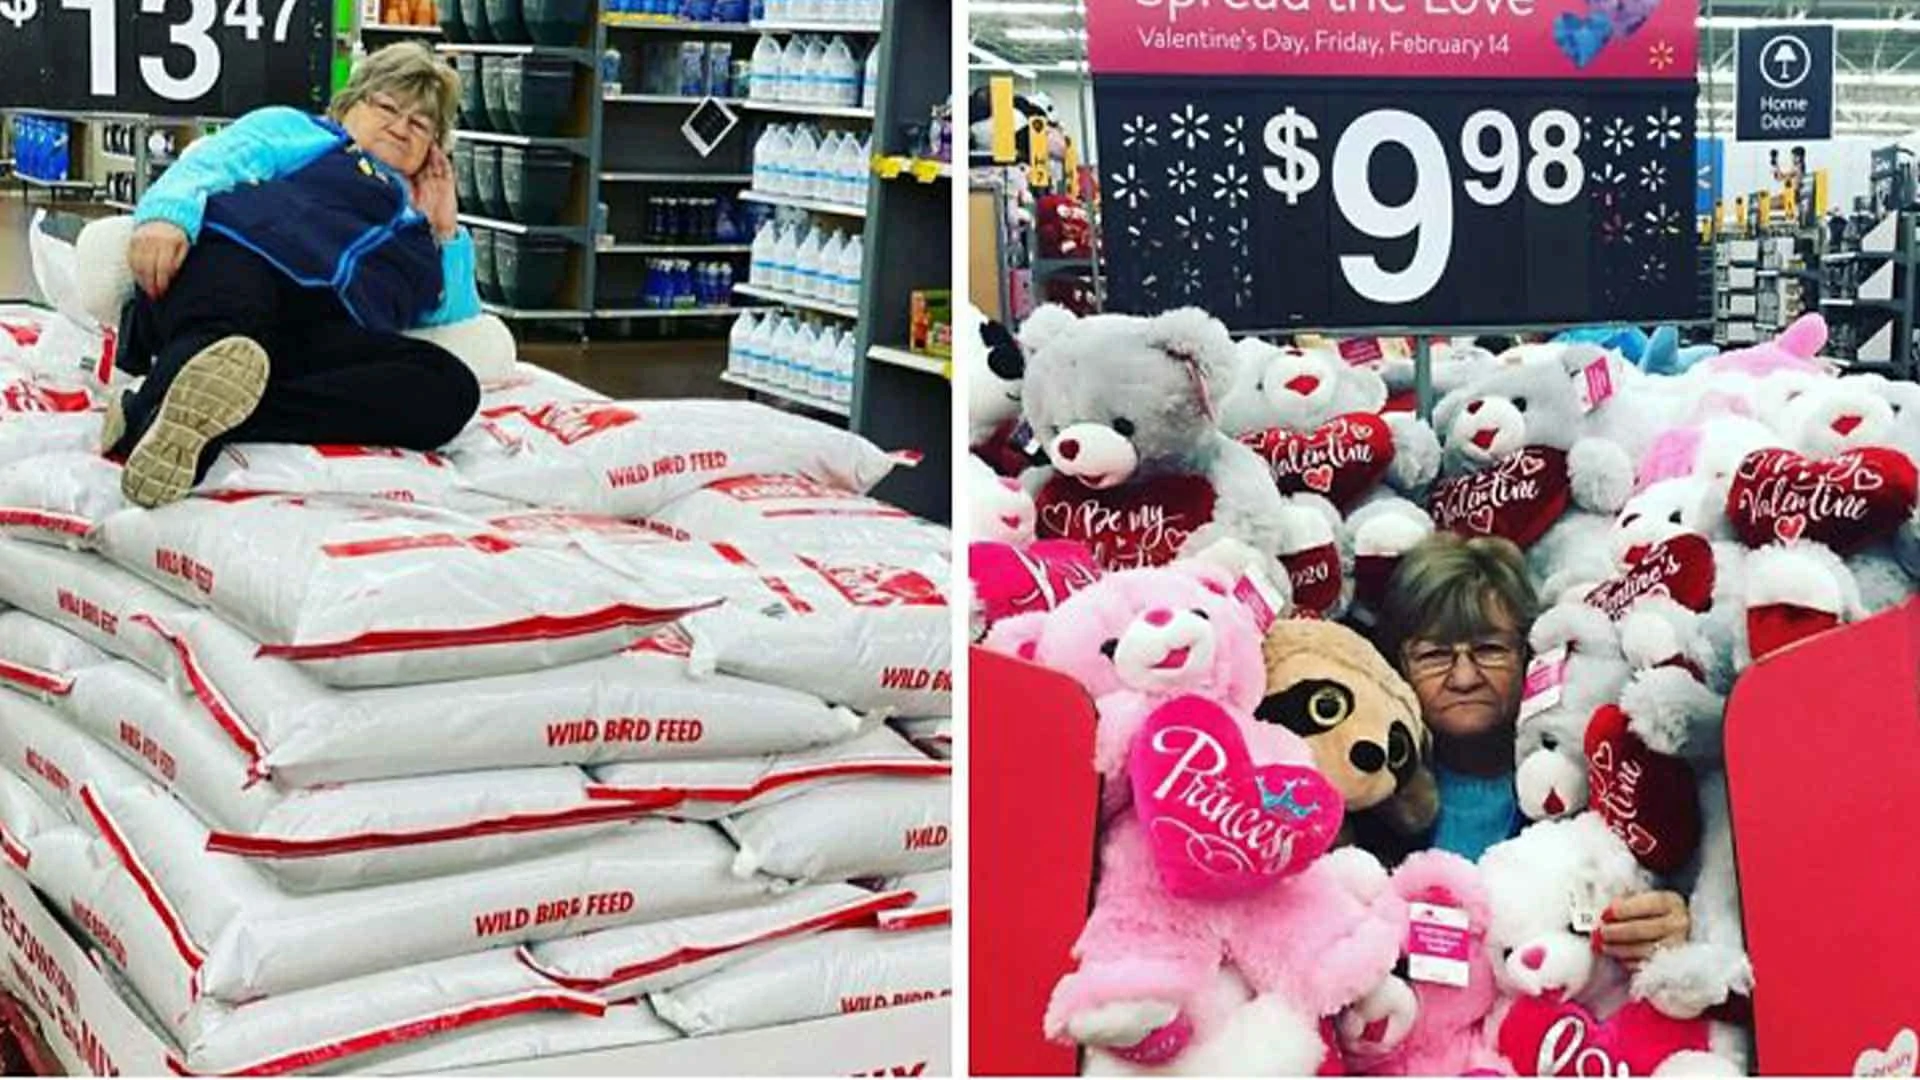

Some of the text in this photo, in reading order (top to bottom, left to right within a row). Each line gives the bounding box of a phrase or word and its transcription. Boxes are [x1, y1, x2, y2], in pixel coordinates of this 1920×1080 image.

[1138, 25, 1510, 61] Valentine's Day, Friday, February 14
[1760, 96, 1808, 112] Home
[606, 463, 649, 488] WILD
[1434, 470, 1539, 528] Valentine
[1738, 472, 1872, 525] Valentine
[1073, 499, 1122, 538] Be
[881, 666, 931, 689] WILD
[547, 719, 600, 748] WILD
[655, 718, 703, 743] FEED
[1152, 724, 1305, 875] Princess
[904, 825, 948, 850] WILD
[475, 907, 531, 937] WILD
[586, 890, 635, 916] FEED
